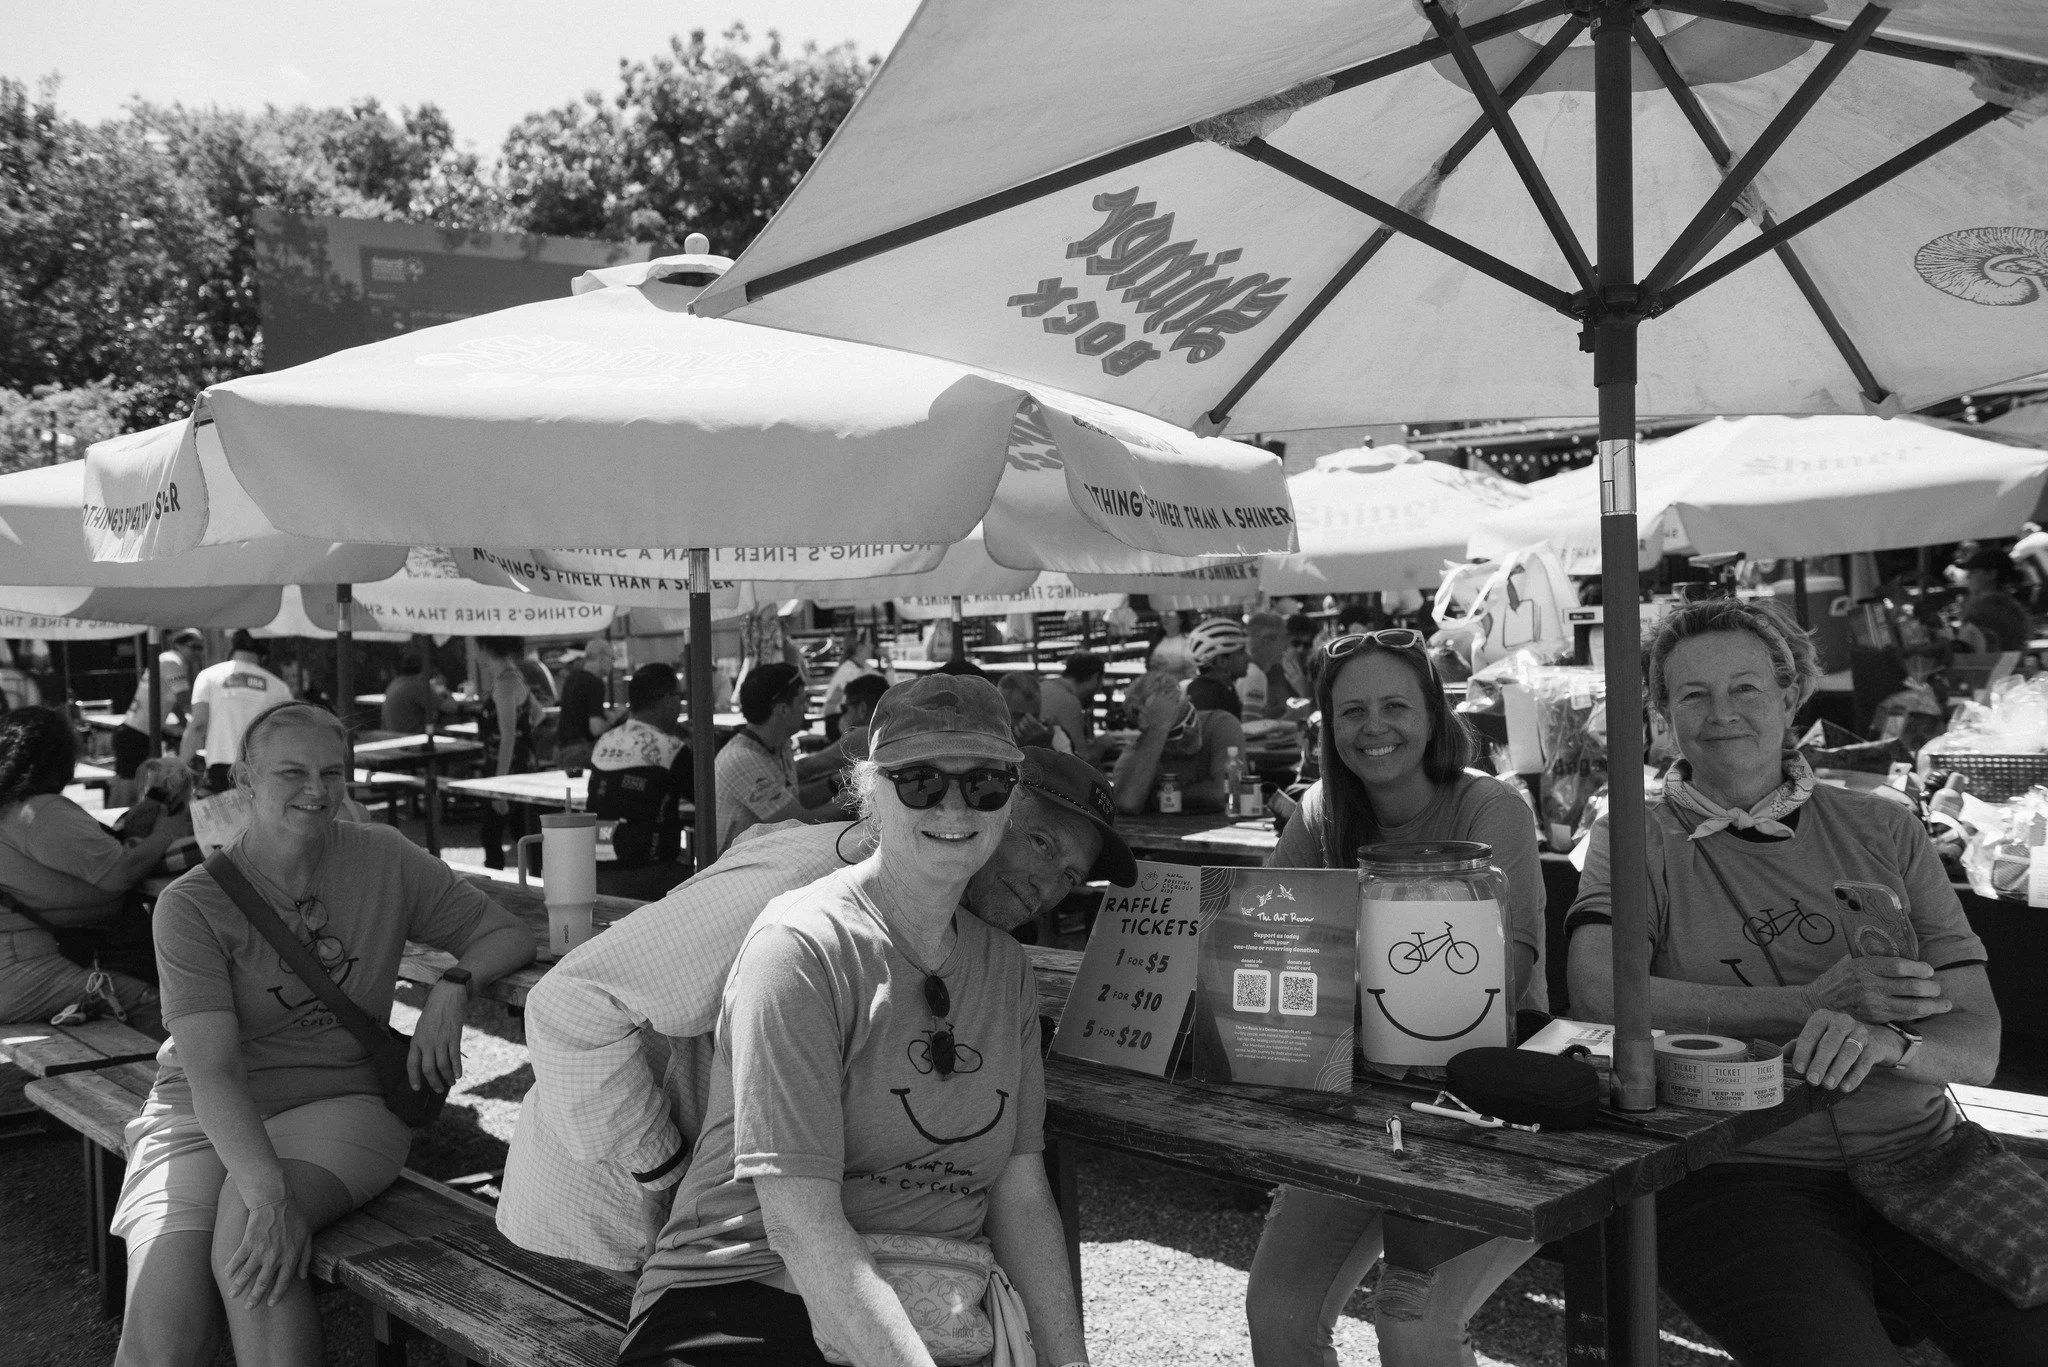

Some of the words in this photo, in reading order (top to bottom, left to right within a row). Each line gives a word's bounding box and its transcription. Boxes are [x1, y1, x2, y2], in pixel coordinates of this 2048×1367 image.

[1183, 506, 1222, 529] THAN
[1221, 508, 1236, 528] A
[1234, 506, 1294, 529] SHINER
[556, 571, 602, 588] FINER
[609, 575, 651, 589] THAN
[657, 578, 669, 591] A
[1104, 897, 1172, 914] RAFFLE
[1257, 912, 1272, 922] The
[1121, 918, 1199, 936] TICKETS
[1253, 931, 1276, 939] Support
[1115, 948, 1125, 966] 1
[1127, 957, 1144, 966] FOR
[1145, 952, 1170, 974] $5
[1098, 984, 1111, 1002] 2
[1113, 991, 1129, 1001] FOR
[1131, 989, 1163, 1012] $10
[1083, 1020, 1095, 1038] 5
[1099, 1027, 1115, 1037] FOR
[1117, 1025, 1152, 1050] $20
[1673, 1063, 1697, 1073] TICKET
[1714, 1068, 1741, 1077] TICKET
[1757, 1064, 1775, 1075] TICKET
[1753, 1088, 1768, 1096] KEEP
